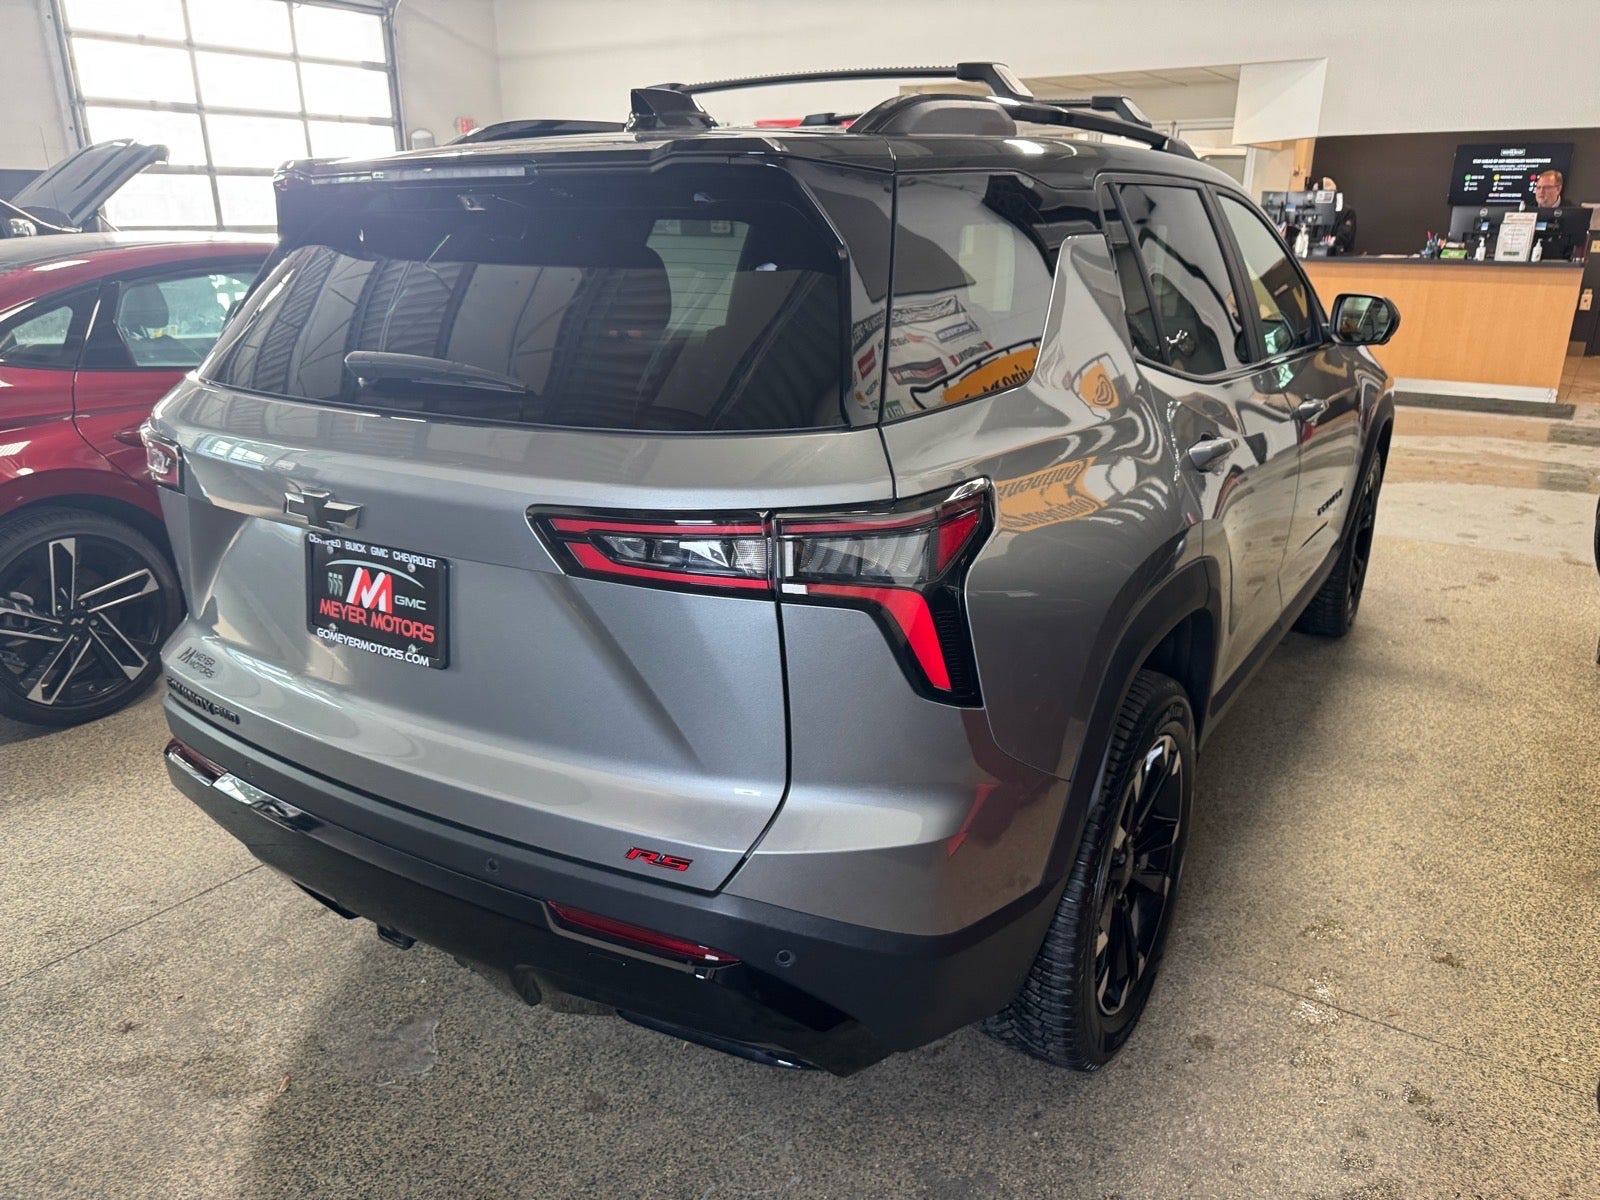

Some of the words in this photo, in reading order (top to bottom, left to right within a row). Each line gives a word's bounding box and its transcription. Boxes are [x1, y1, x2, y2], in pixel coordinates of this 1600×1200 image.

[344, 541, 367, 554] BUICK
[370, 546, 388, 559] GMC
[392, 551, 437, 569] CHEVROLET
[394, 595, 426, 611] GMC
[319, 598, 367, 626] MEYER
[370, 611, 435, 643] MOTORS
[316, 627, 430, 667] GOMEYERMOTORS.COM
[625, 846, 694, 872] RS
